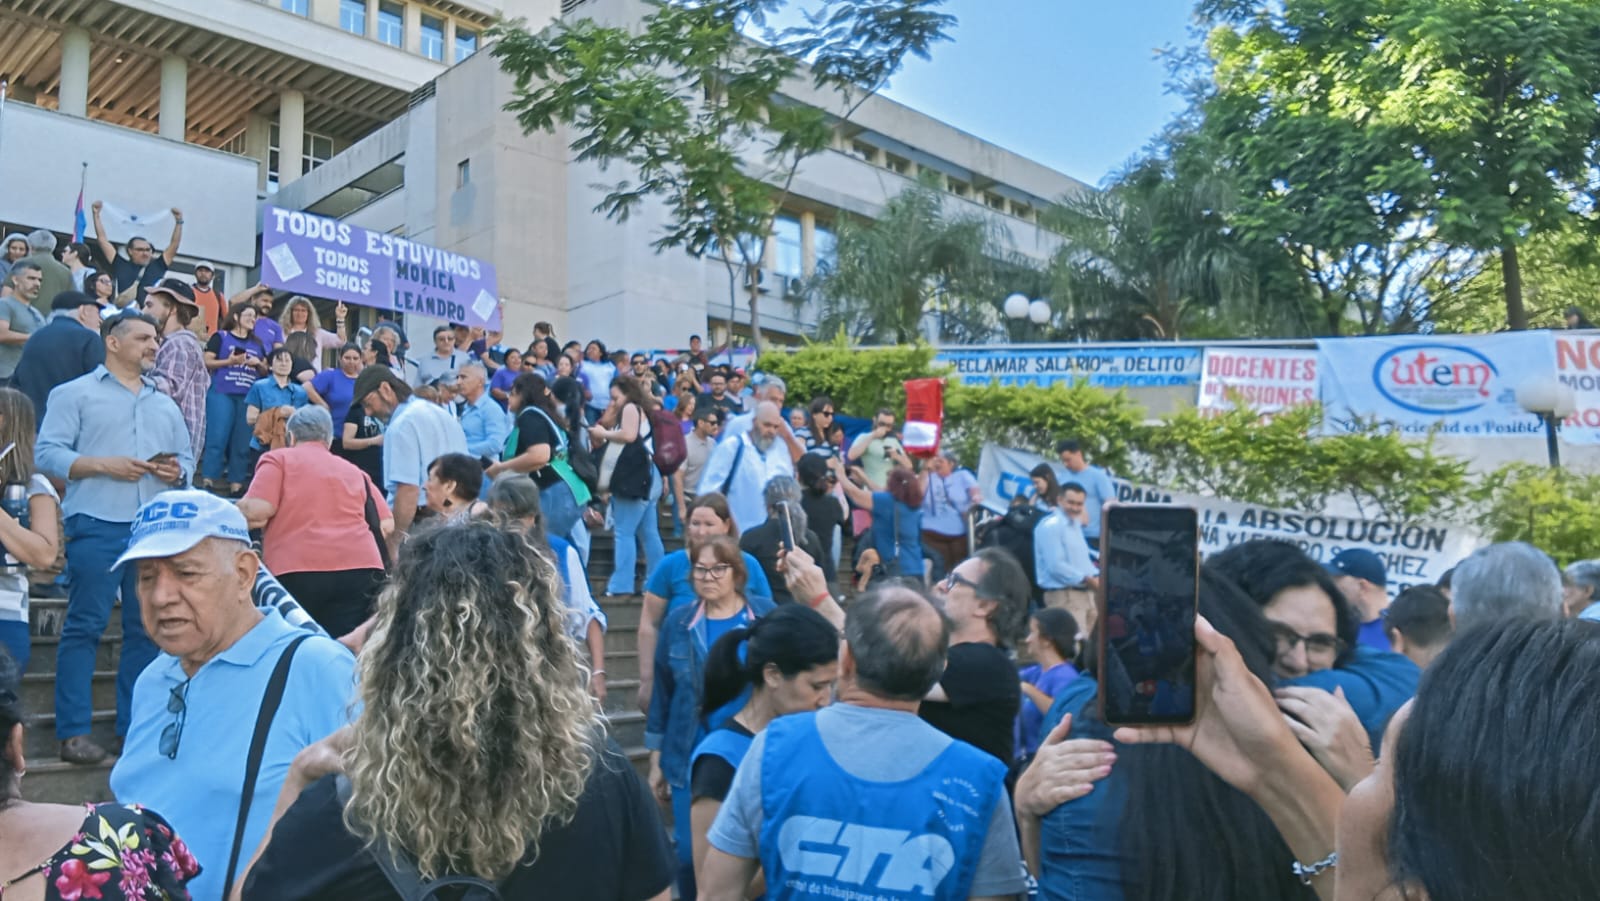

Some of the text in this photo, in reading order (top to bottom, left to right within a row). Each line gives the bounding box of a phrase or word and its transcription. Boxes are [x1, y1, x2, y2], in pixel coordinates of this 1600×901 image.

[272, 207, 481, 280] TODOS ESTUVIMOS
[314, 246, 369, 275] TODOS
[315, 267, 372, 296] SOMOS
[1036, 355, 1101, 373] SALARIO
[1124, 355, 1185, 373] DELITO
[1207, 355, 1317, 382] DOCENTES
[1391, 351, 1491, 398] utem
[1238, 508, 1447, 552] ABSOLUCION
[1331, 545, 1428, 578] SCHEZ
[777, 814, 956, 897] CTA
